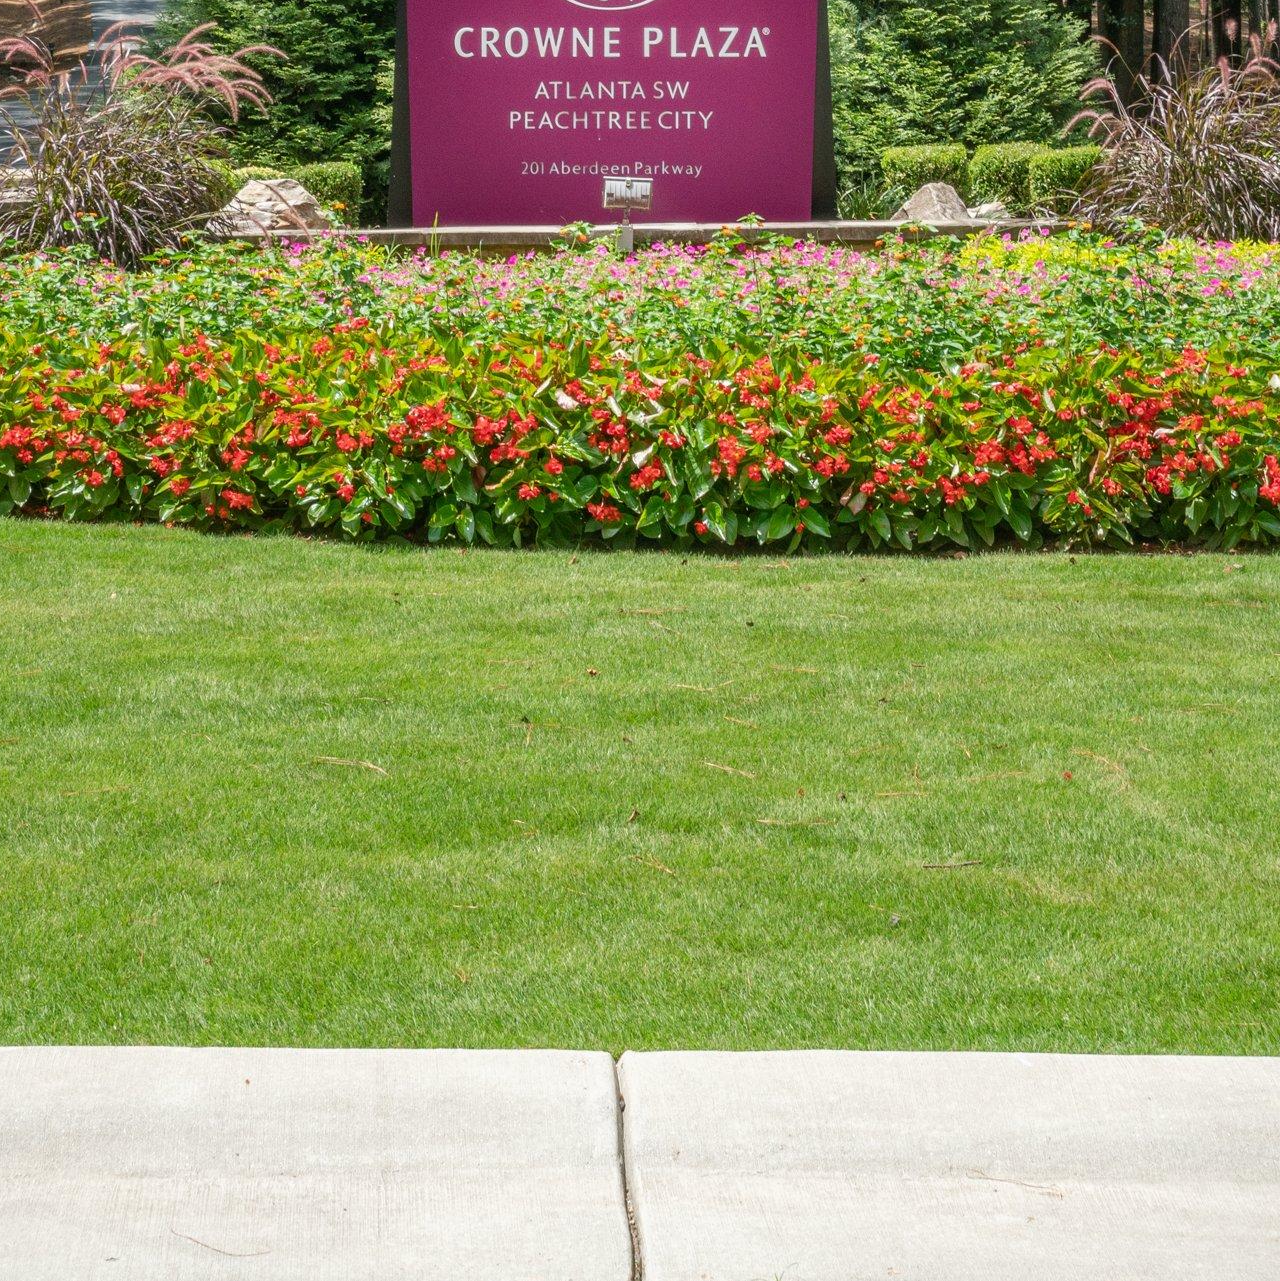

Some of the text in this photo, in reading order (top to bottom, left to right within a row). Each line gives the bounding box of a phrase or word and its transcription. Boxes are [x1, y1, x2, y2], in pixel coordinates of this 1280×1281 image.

[453, 25, 621, 59] CROWNE
[534, 80, 690, 100] ATLANTA SW
[509, 110, 714, 130] PEACHTREE CITY
[520, 161, 703, 178] 201 Aberdeen Parkway
